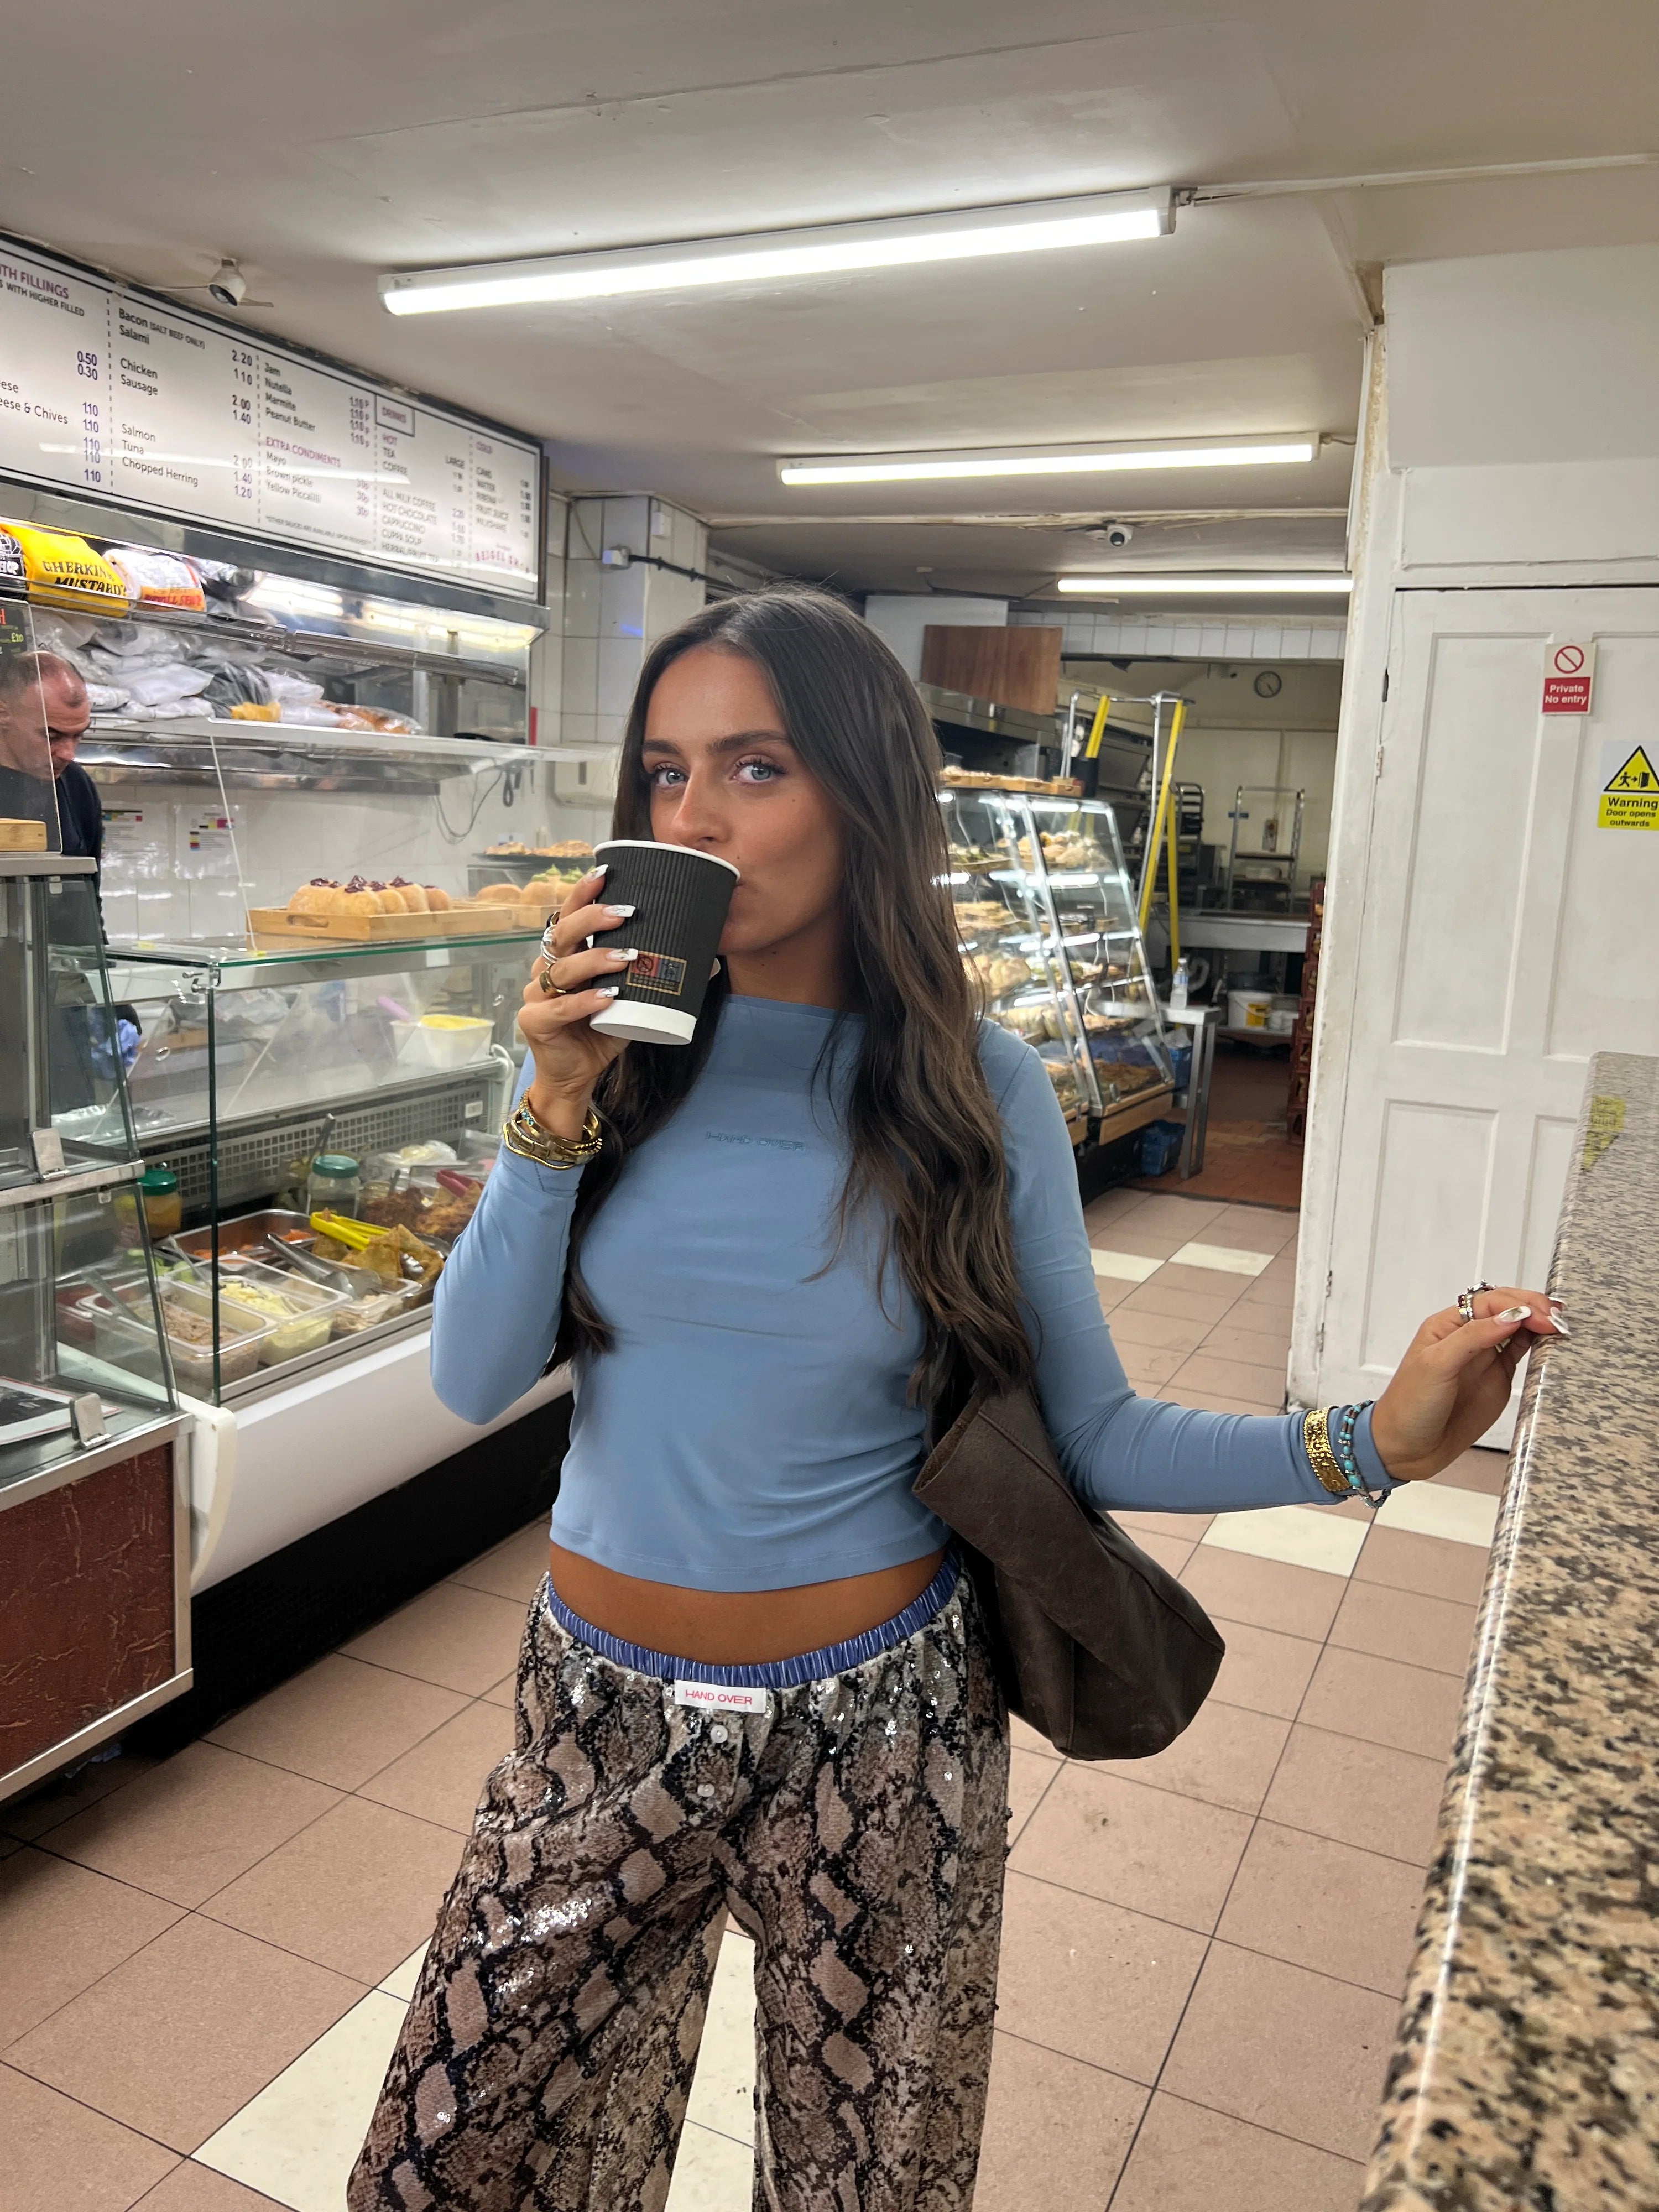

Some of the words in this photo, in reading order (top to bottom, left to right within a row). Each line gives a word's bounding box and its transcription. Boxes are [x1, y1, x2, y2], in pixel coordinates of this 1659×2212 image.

[20, 271, 69, 299] FILLINGS
[6, 282, 28, 297] WITH
[29, 290, 58, 307] HIGHER
[60, 301, 85, 316] FILLED
[119, 307, 148, 328] Bacon
[119, 324, 150, 345] Salami
[77, 351, 97, 366] 0.50
[77, 363, 98, 380] 0.30
[120, 357, 158, 379] Chicken
[0, 380, 19, 393] ese
[121, 374, 158, 396] Sausage
[24, 403, 31, 413] &
[34, 405, 69, 425] Chives
[122, 423, 156, 442] Salmon
[122, 440, 144, 455] Tuna
[266, 436, 290, 452] EXTRA
[291, 444, 342, 468] CONDIMENTS
[267, 451, 287, 466] Mayo
[122, 456, 164, 476] Chopped
[165, 467, 199, 487] Herring
[267, 478, 290, 495] Yellow
[1549, 684, 1584, 693] Private
[1545, 695, 1559, 704] No
[1561, 694, 1587, 706] entry
[1608, 797, 1658, 811] Warning
[1629, 810, 1656, 818] opens
[705, 1131, 752, 1145] HAND
[758, 1137, 805, 1152] OVER
[685, 1689, 715, 1702] HAND
[718, 1694, 753, 1705] OVER
